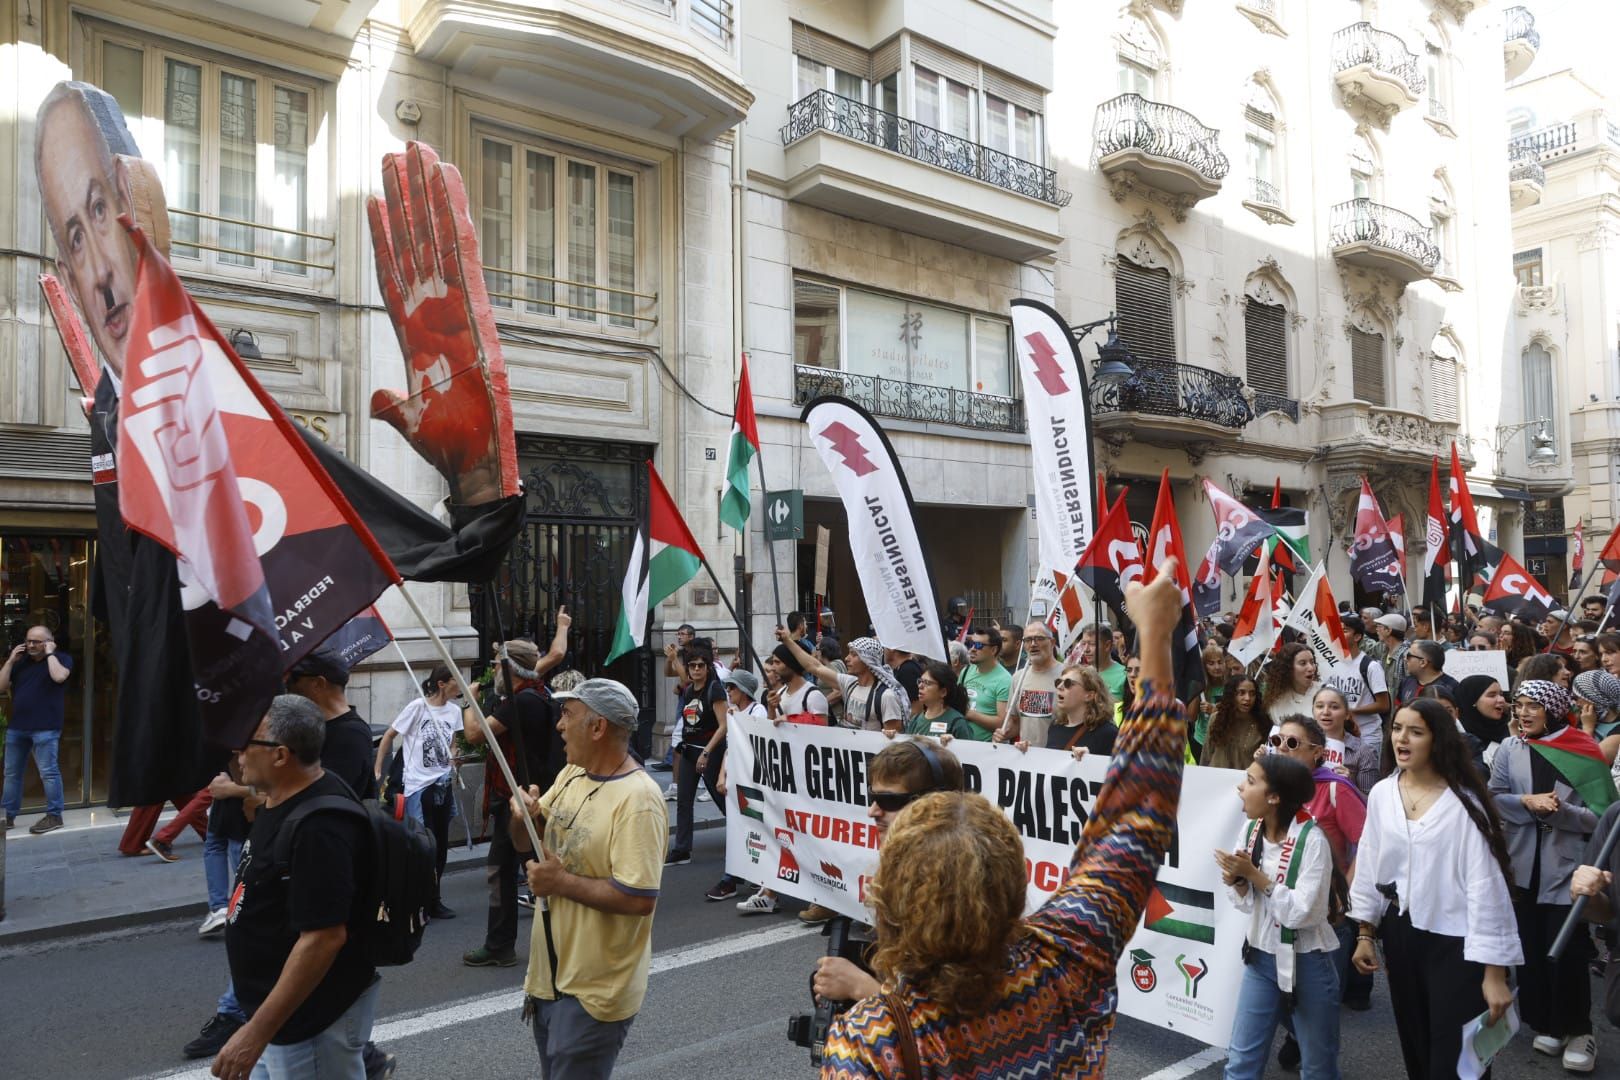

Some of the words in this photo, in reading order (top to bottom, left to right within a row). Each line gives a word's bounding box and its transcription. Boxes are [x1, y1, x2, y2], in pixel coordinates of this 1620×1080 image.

[706, 449, 716, 460] 27
[749, 734, 797, 794] VAGA
[779, 866, 799, 882] CGT
